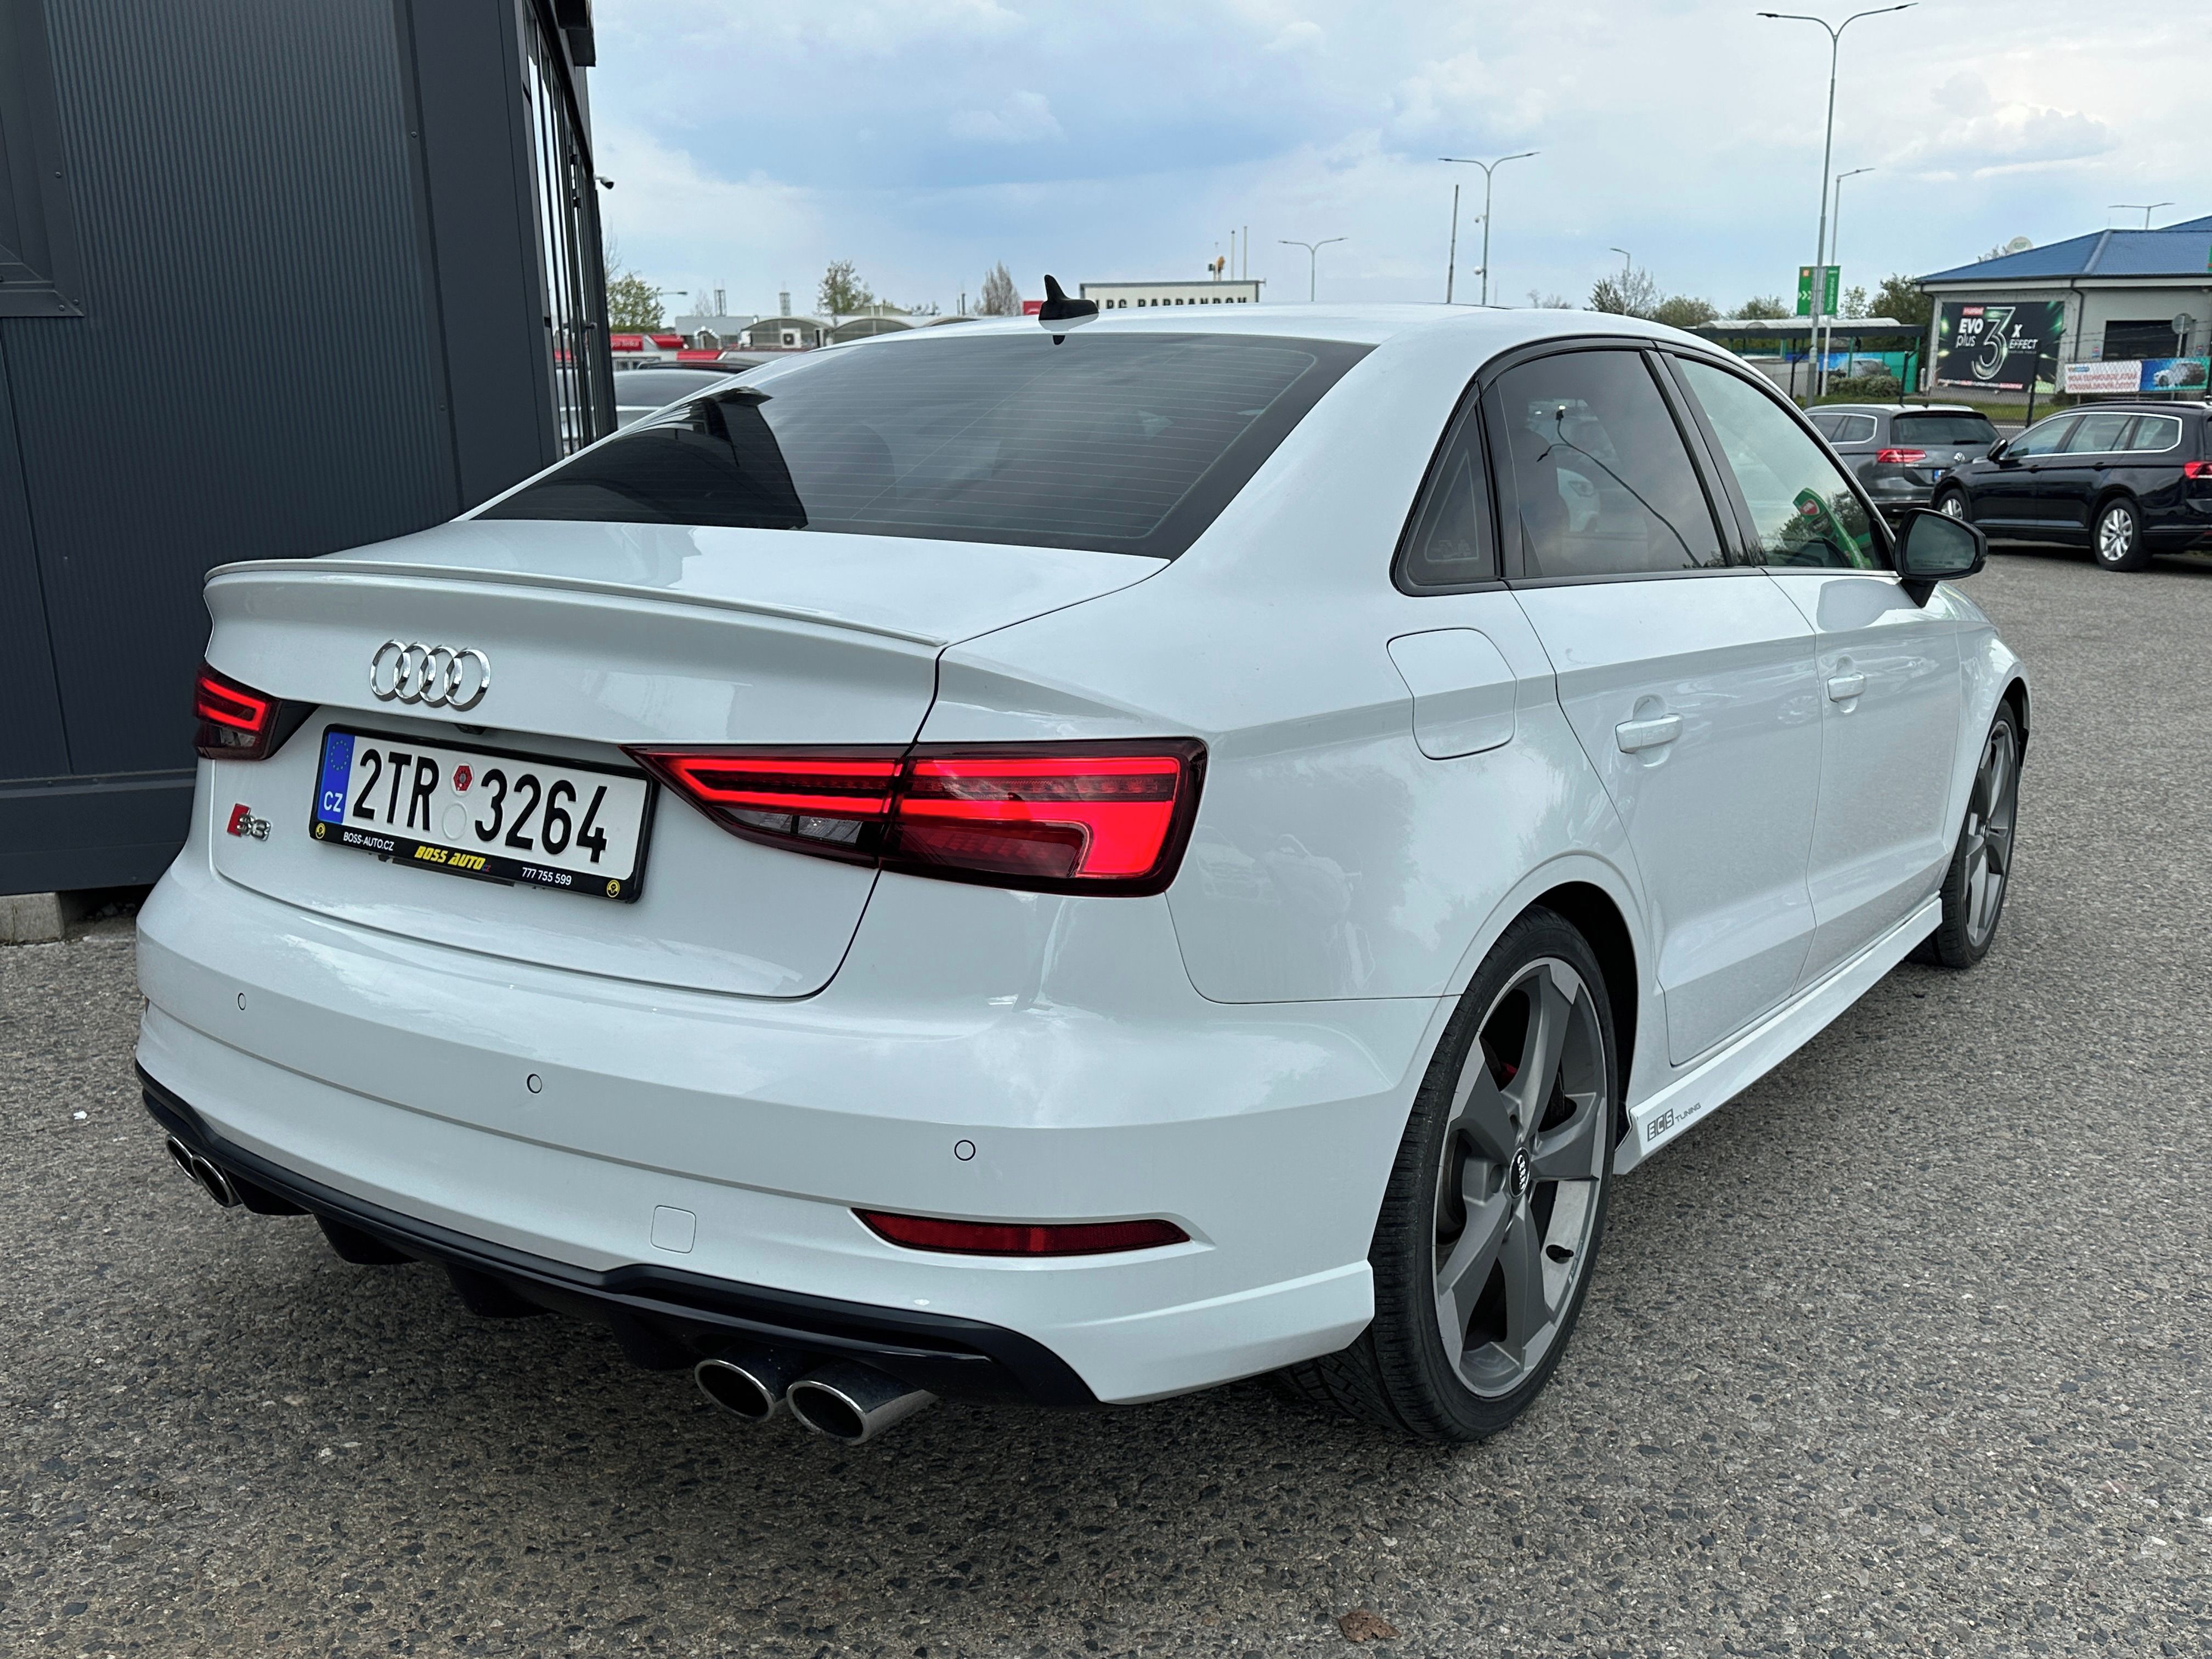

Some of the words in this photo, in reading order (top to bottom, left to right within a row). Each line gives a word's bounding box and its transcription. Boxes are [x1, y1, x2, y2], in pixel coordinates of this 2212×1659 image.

[1958, 318, 1984, 334] EVO
[1955, 332, 1976, 348] plus
[1971, 306, 2016, 380] 3
[2008, 338, 2039, 349] EFFECT
[323, 791, 343, 813] CZ
[353, 748, 439, 832] 2TR
[475, 769, 608, 864] 3264
[343, 831, 394, 851] BOSS-AUTO.CZ
[414, 845, 448, 863] BOSS
[447, 853, 486, 871] AUTO
[522, 867, 537, 879] 777
[538, 870, 554, 883] 755
[554, 873, 572, 886] 599
[1647, 1108, 1674, 1142] ECS
[1675, 1102, 1702, 1122] TUNING
